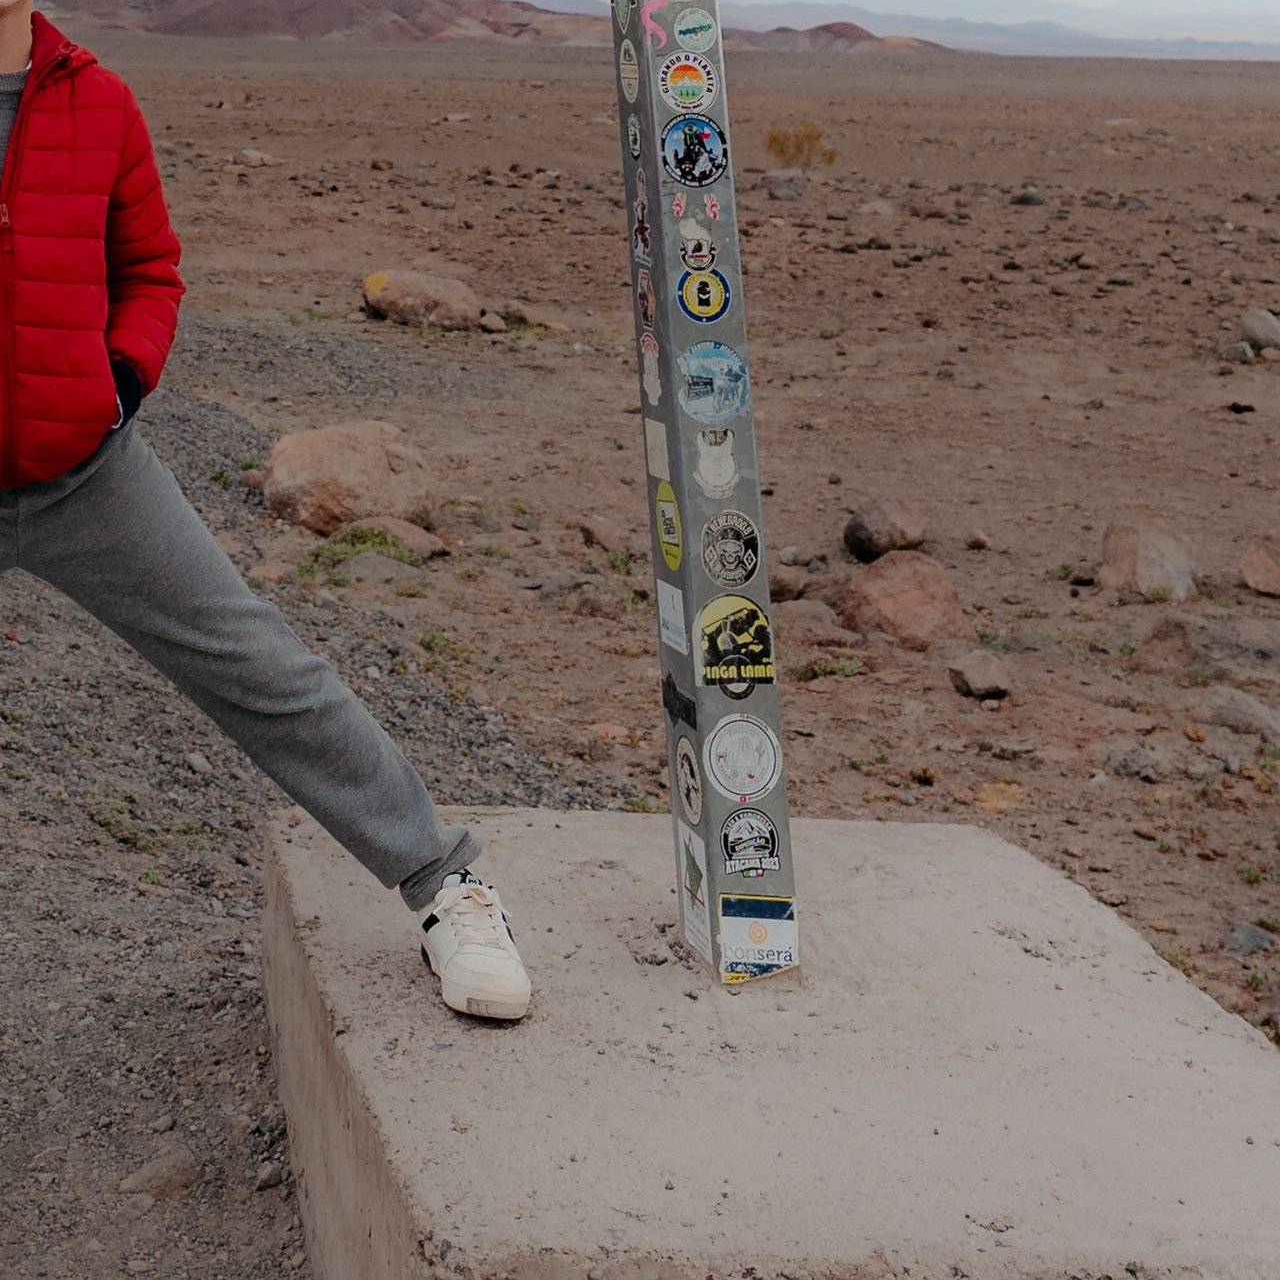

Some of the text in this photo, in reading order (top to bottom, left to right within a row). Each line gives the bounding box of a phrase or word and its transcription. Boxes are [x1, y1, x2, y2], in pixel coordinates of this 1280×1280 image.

[663, 56, 713, 94] GIRANDO PLANETA
[740, 665, 774, 678] LAMA
[723, 946, 792, 962] bonserá
